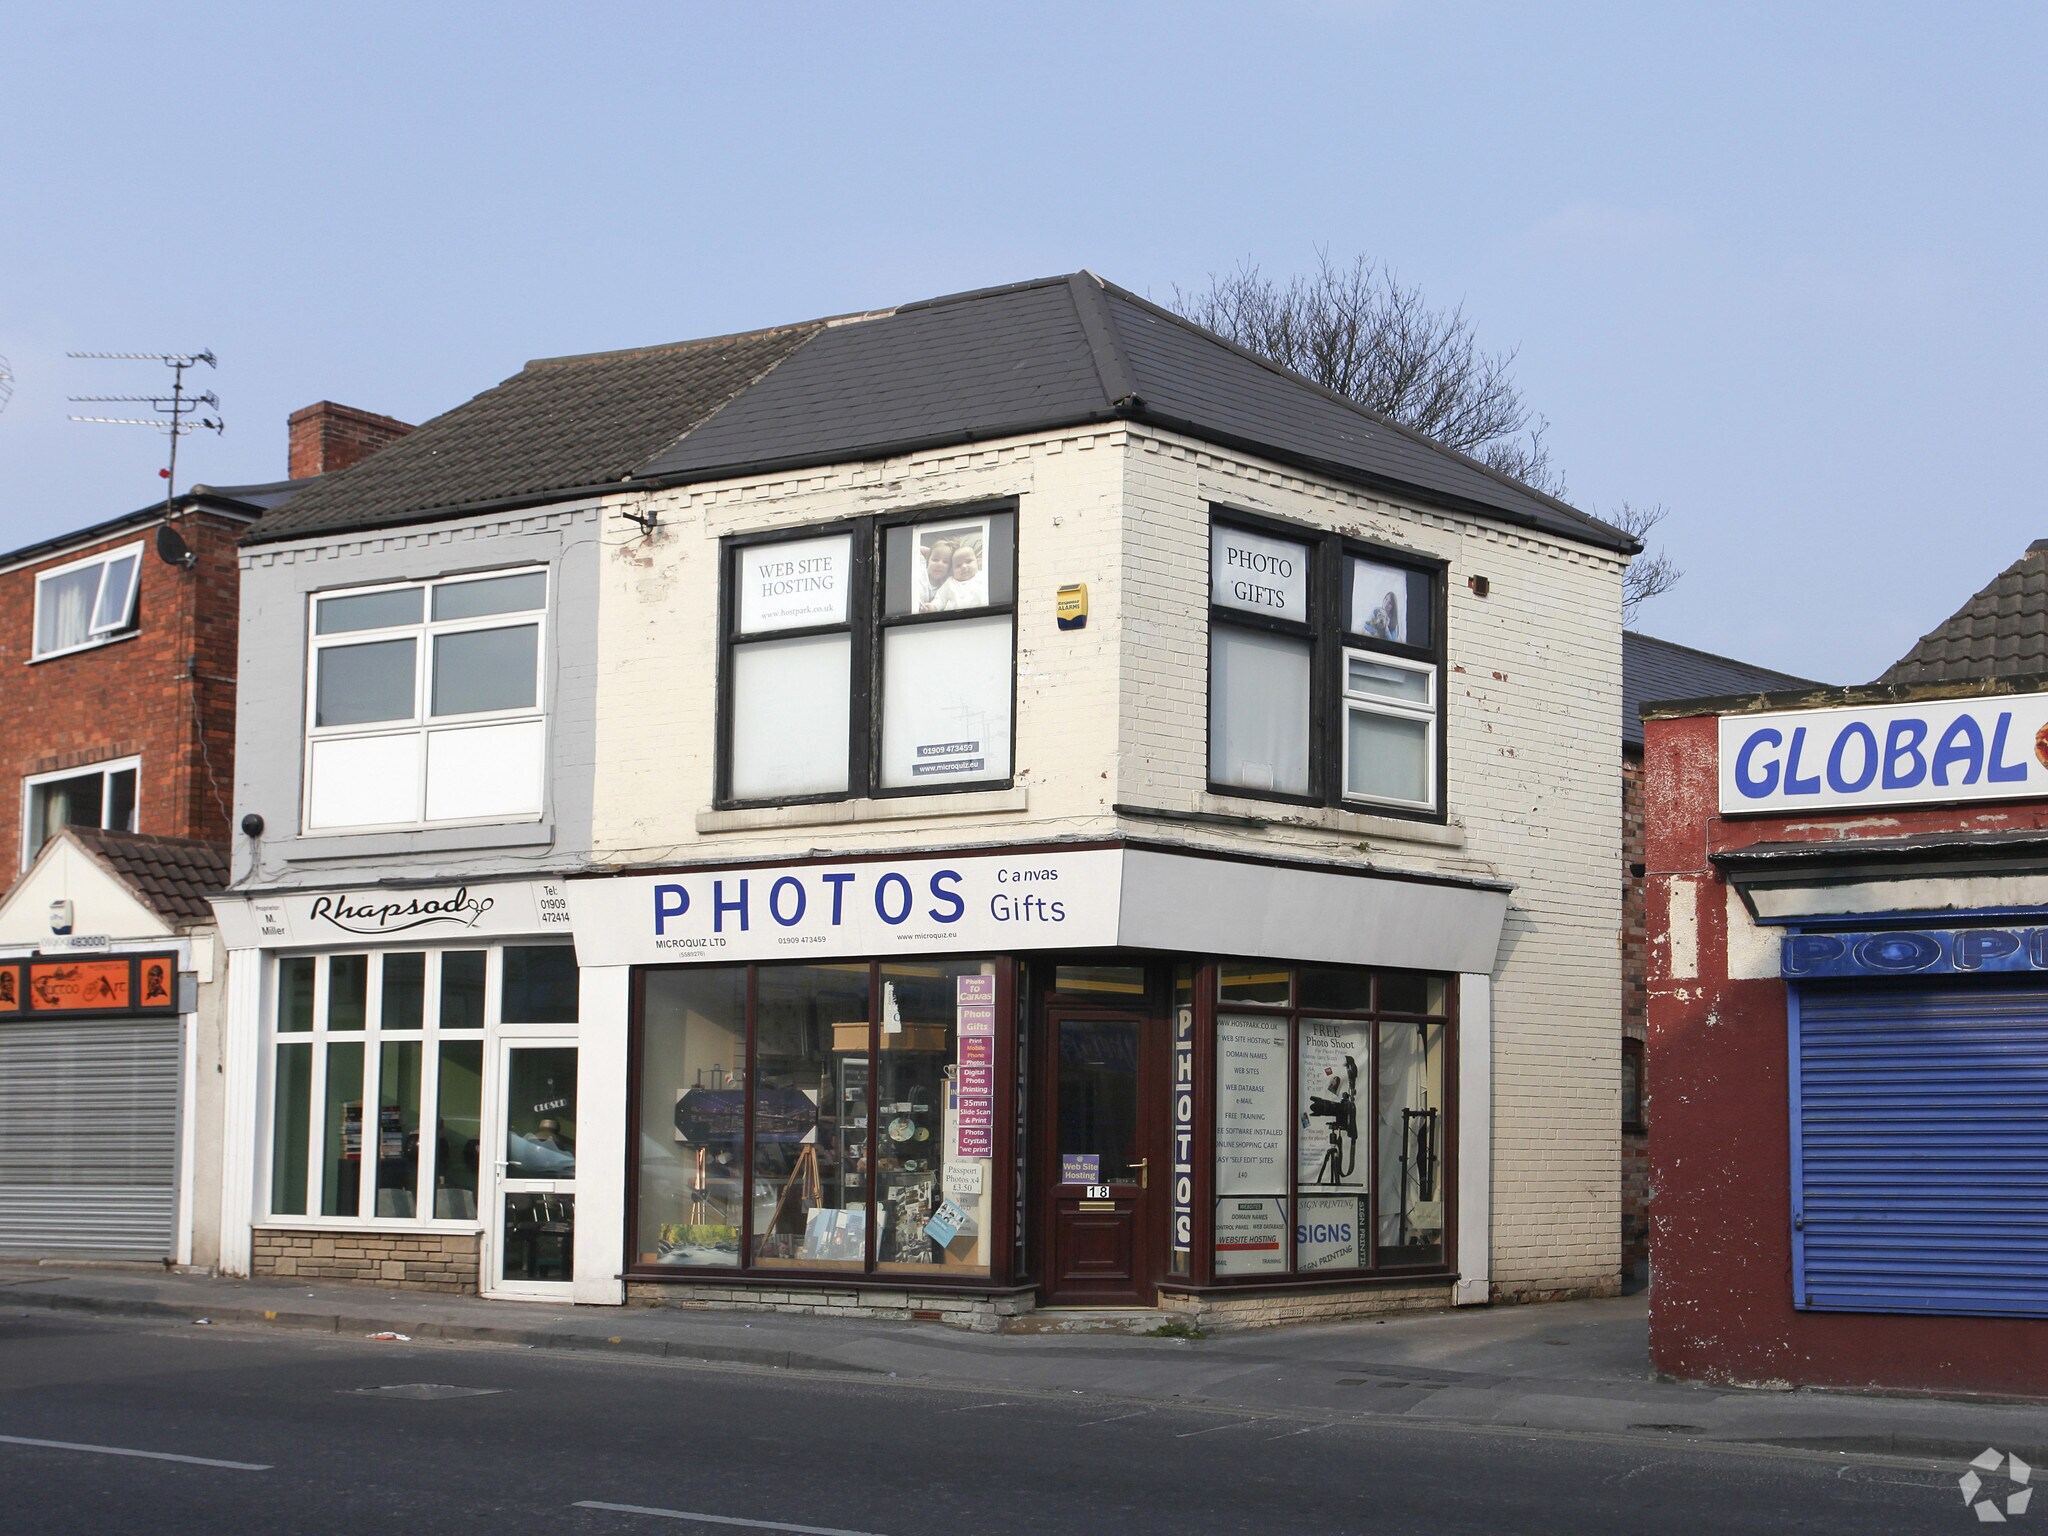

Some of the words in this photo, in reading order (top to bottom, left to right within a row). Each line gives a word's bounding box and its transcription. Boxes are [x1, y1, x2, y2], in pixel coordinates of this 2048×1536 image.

[759, 562, 794, 579] WEB
[798, 557, 832, 574] SITE
[1227, 547, 1292, 578] PHOTO
[761, 575, 834, 597] HOSTING
[1234, 581, 1285, 608] GIFTS
[761, 604, 834, 619] www.hostpark.co.uk
[923, 747, 945, 755] 01909
[946, 744, 973, 752] 473459
[1735, 712, 2028, 799] GLOBAL
[920, 761, 979, 772] www.microquiz.eu
[997, 868, 1058, 883] Canvas
[543, 886, 558, 896] Tel:
[540, 899, 566, 910] 01909
[654, 869, 965, 936] PHOTOS
[990, 893, 1066, 922] Gifts
[265, 914, 277, 923] M.
[542, 912, 570, 923] 472414
[262, 926, 285, 936] Miller
[71, 936, 106, 947] 483000
[656, 938, 707, 949] MICROQUIZ
[709, 938, 726, 947] LTD
[960, 992, 992, 1001] Canvas
[964, 1010, 991, 1018] Photo
[966, 1022, 988, 1031] Gifts
[1313, 1024, 1341, 1038] FREE
[1247, 1037, 1271, 1045] HOSTING
[1306, 1036, 1329, 1048] Photo
[1331, 1038, 1355, 1049] Shoot
[1249, 1052, 1268, 1060] NAMES
[964, 1069, 985, 1077] Digital
[962, 1086, 988, 1094] Printing
[533, 1098, 567, 1112] CLOSED
[1176, 1008, 1192, 1243] PHOTOS
[963, 1137, 988, 1145] Crystals
[948, 1165, 977, 1175] Passport
[1083, 1163, 1099, 1171] Site
[946, 1175, 969, 1184] Photos
[1065, 1171, 1096, 1180] Hosting
[1089, 1186, 1108, 1198] 18
[1299, 1200, 1318, 1211] SIGN
[1320, 1199, 1354, 1209] PRINTING
[1297, 1223, 1352, 1244] SIGNS
[1219, 1236, 1248, 1244] WEBSITE
[1249, 1235, 1277, 1243] HOSTING
[1319, 1244, 1353, 1265] PRINTING
